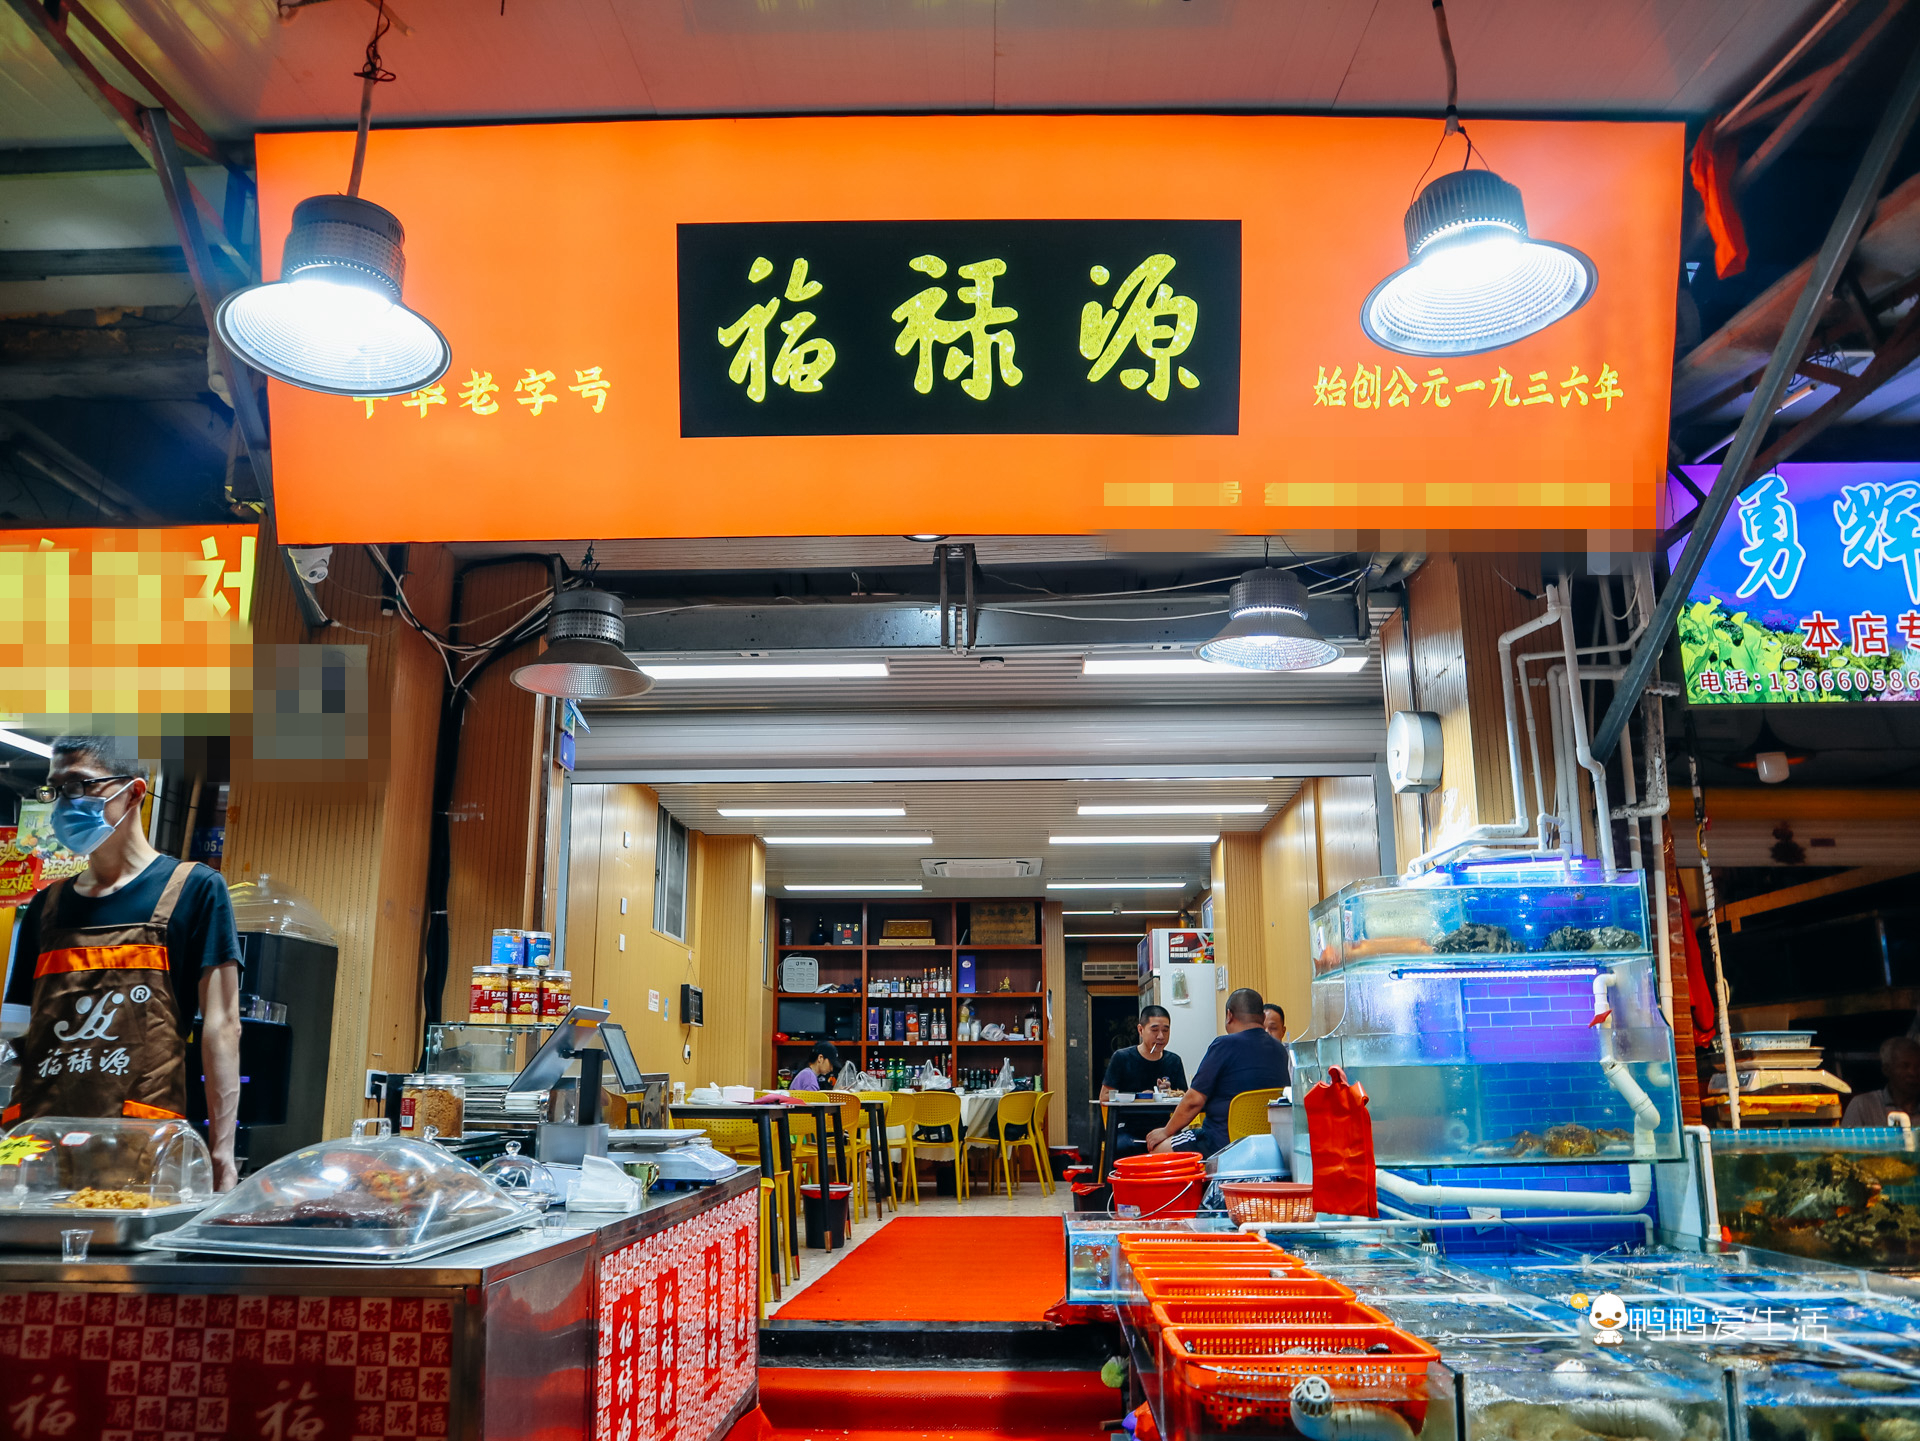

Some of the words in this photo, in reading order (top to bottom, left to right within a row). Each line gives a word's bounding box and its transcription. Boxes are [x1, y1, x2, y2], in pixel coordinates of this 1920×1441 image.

[717, 254, 1200, 403] 福禄源
[1313, 362, 1624, 411] 始创公元一九三六年
[38, 1047, 131, 1078] 福禄源
[660, 1280, 674, 1416] 福禄源
[707, 1251, 719, 1369] 福禄源
